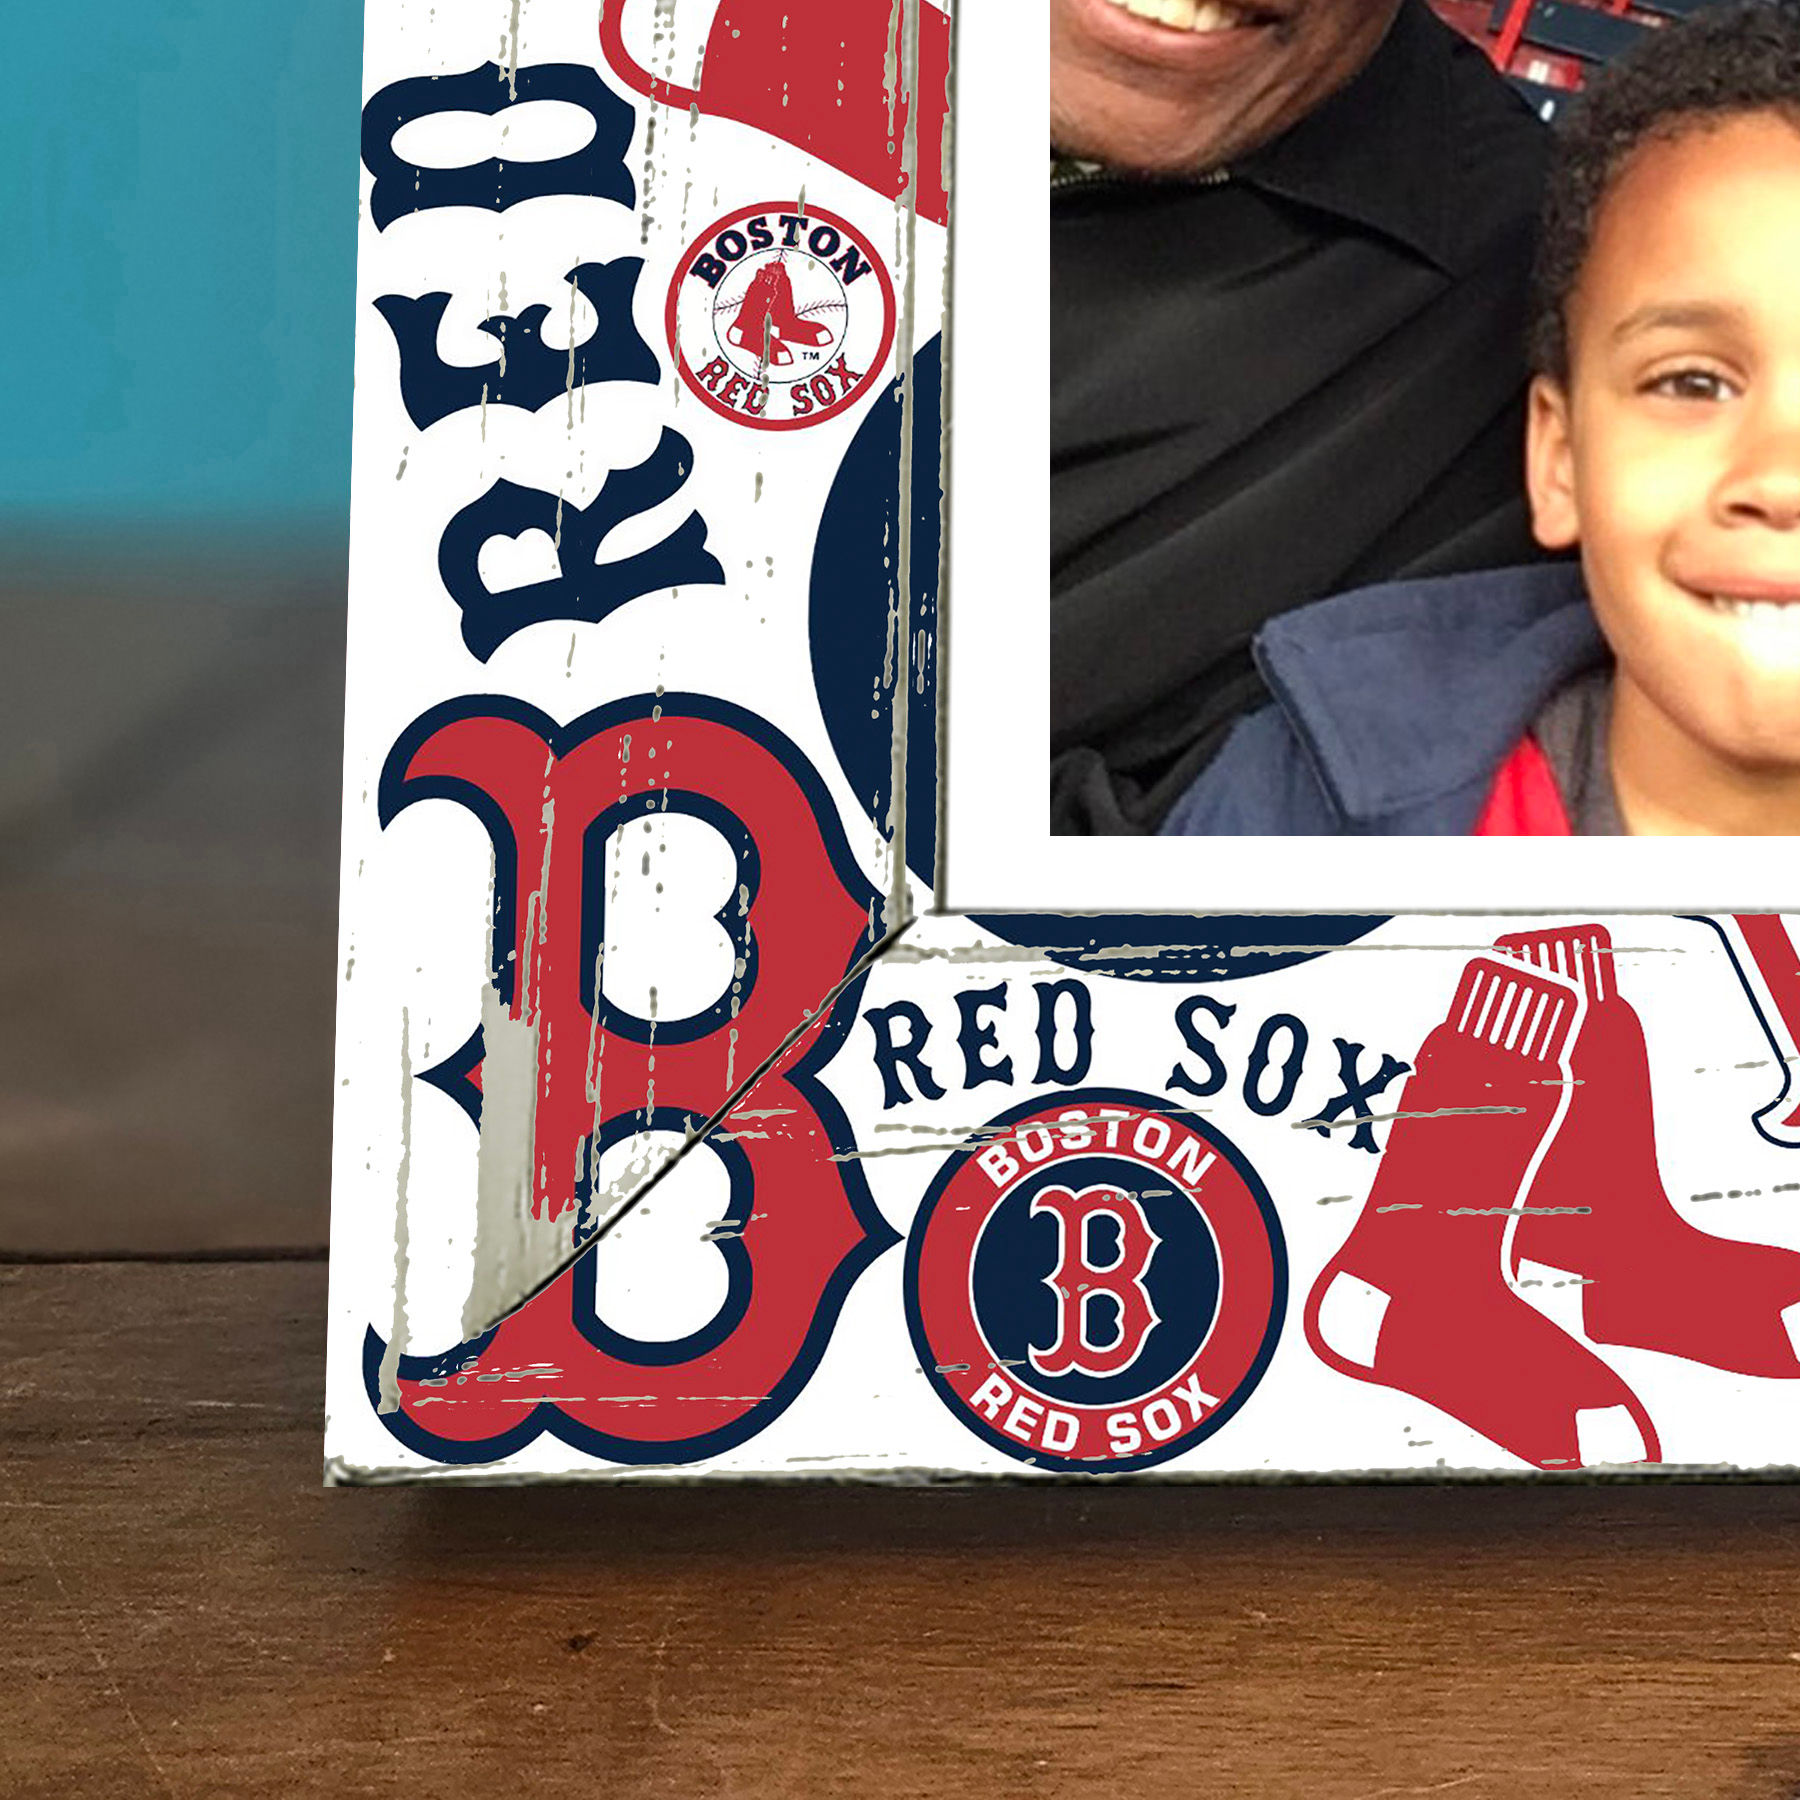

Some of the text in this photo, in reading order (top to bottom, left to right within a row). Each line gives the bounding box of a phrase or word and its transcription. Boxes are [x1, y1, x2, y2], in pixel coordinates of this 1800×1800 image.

[689, 215, 872, 289] BOSTON
[360, 60, 726, 665] RED
[696, 352, 864, 417] RED SOX
[803, 352, 819, 361] TM
[864, 979, 1412, 1154] RED SOX
[977, 1108, 1217, 1188] BOSTON
[1027, 1183, 1163, 1378] B
[969, 1372, 1221, 1454] RED SOX
